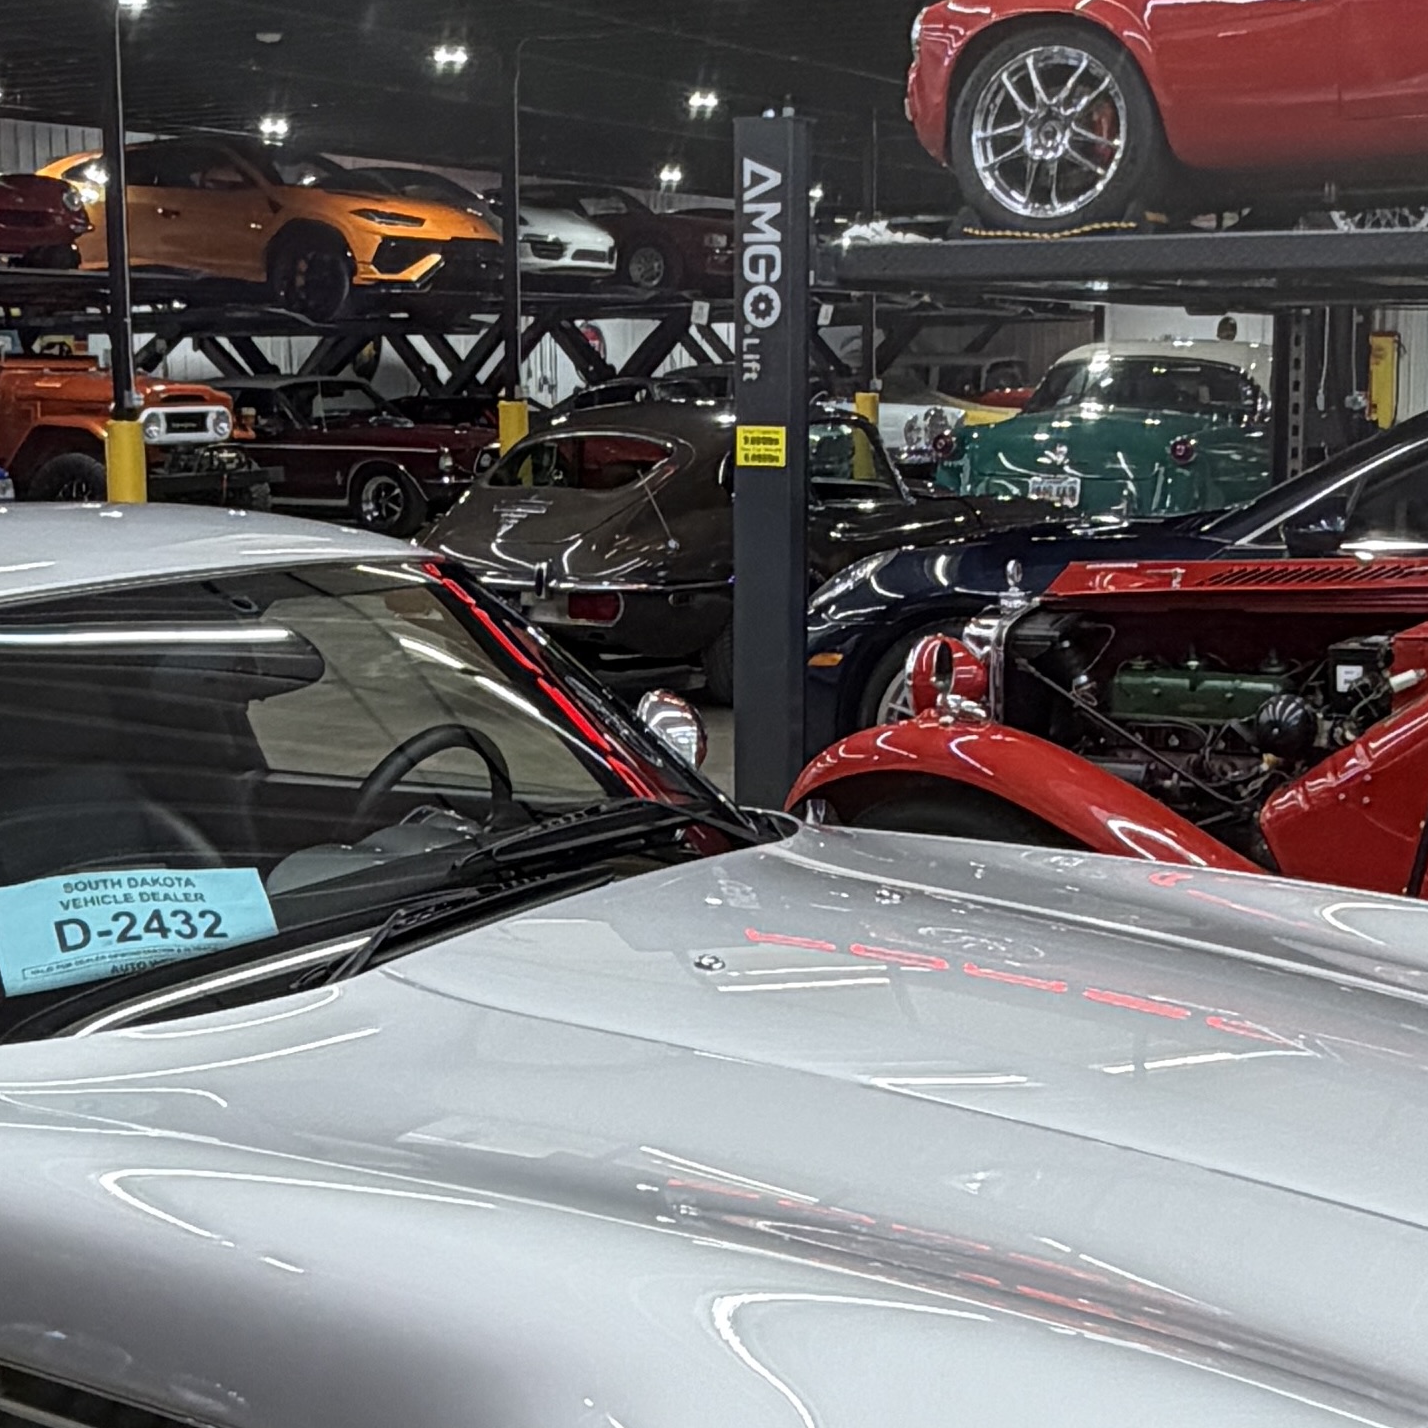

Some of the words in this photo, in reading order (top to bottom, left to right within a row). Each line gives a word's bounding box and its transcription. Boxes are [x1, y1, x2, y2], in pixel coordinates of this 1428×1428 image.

[742, 157, 782, 328] AMGO
[63, 876, 122, 893] SOUTH
[127, 876, 195, 889] DAKOTA
[59, 892, 134, 911] VEHICLE
[139, 891, 206, 904] DEALER
[54, 909, 228, 953] D-2432
